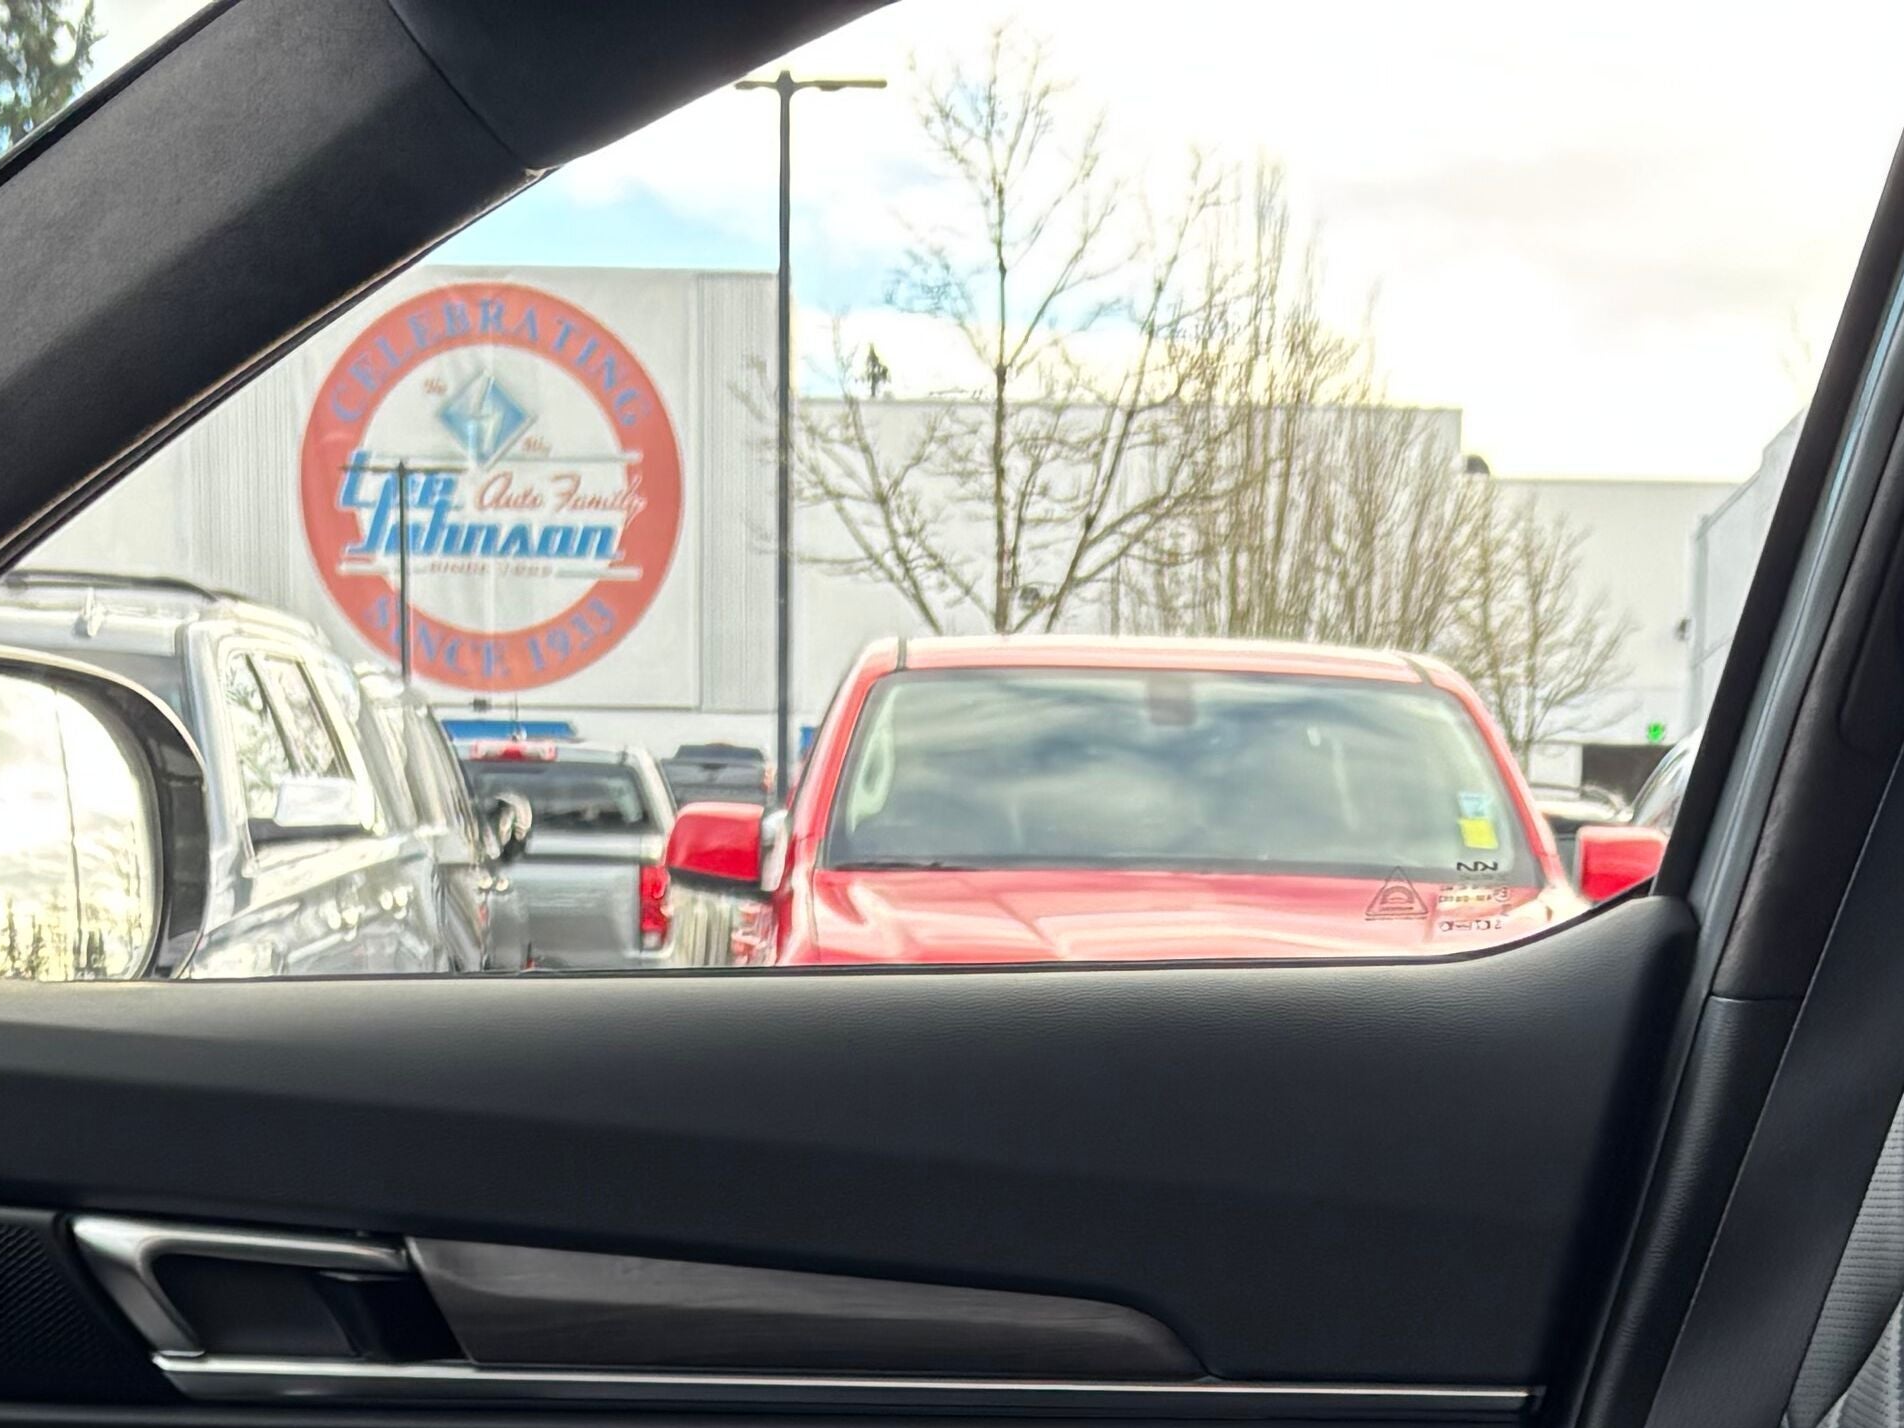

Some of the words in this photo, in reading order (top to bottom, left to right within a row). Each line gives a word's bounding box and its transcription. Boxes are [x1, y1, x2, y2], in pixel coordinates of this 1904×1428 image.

[329, 297, 652, 427] CELEBRATING
[345, 474, 625, 560] Johnson
[476, 471, 543, 513] Auto
[551, 472, 647, 527] Family
[527, 596, 616, 672] 1933
